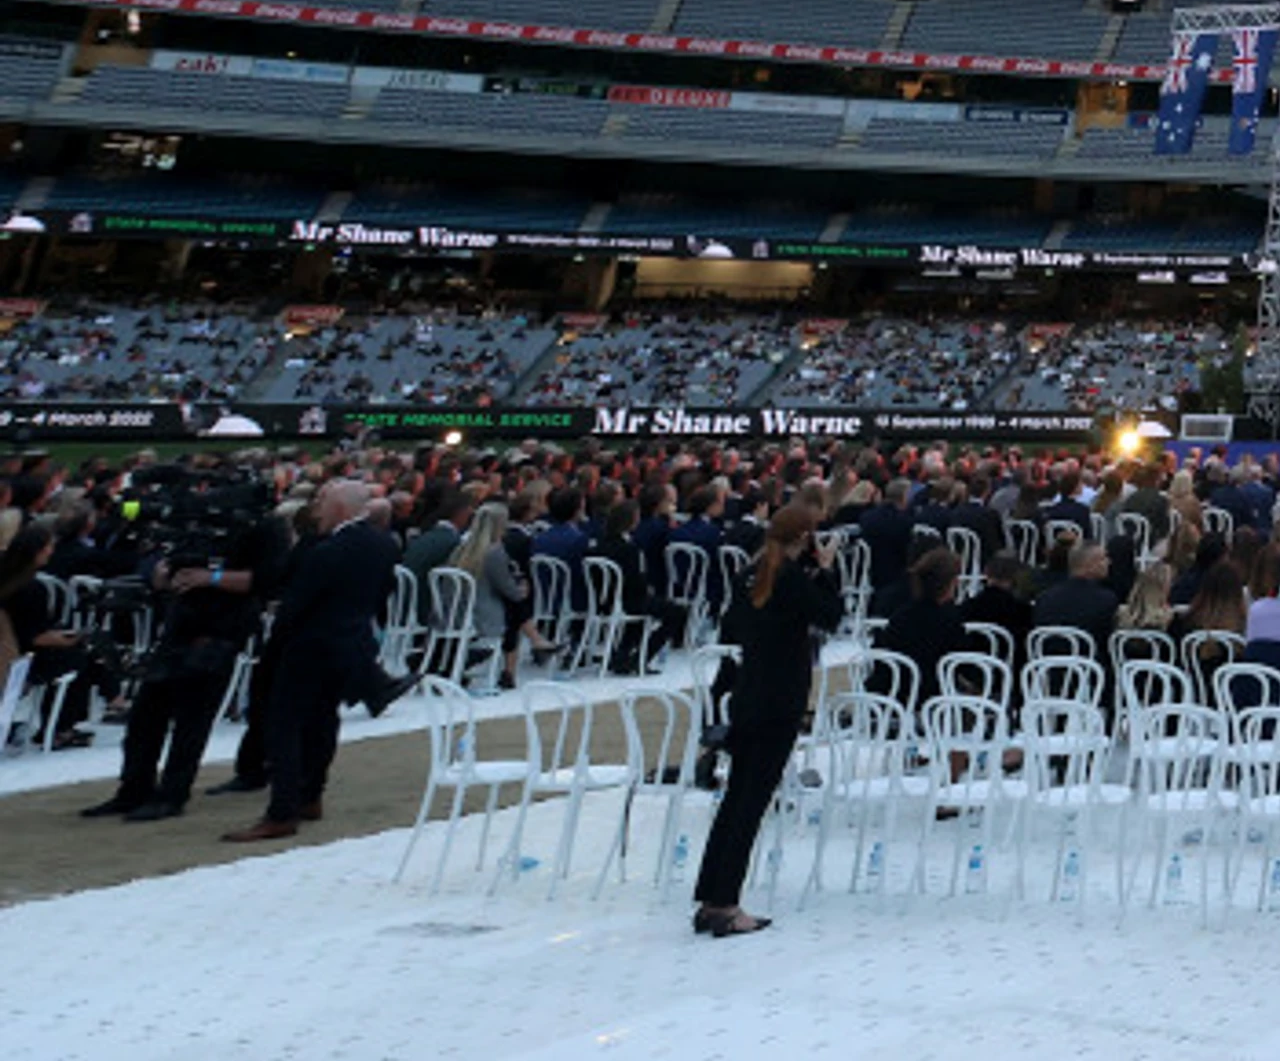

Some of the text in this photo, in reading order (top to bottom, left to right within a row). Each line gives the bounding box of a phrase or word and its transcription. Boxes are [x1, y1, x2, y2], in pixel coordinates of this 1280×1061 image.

[289, 220, 334, 241] Mr
[336, 224, 414, 244] Shane
[419, 227, 498, 247] Warne
[920, 245, 954, 262] Mr
[955, 245, 1017, 267] Shane
[1022, 248, 1085, 267] Warne
[47, 412, 106, 426] March
[402, 414, 494, 427] MEMORIAL
[500, 414, 573, 427] SERVICE
[592, 406, 647, 433] Mr
[650, 407, 751, 434] Shane
[761, 408, 862, 434] Warne
